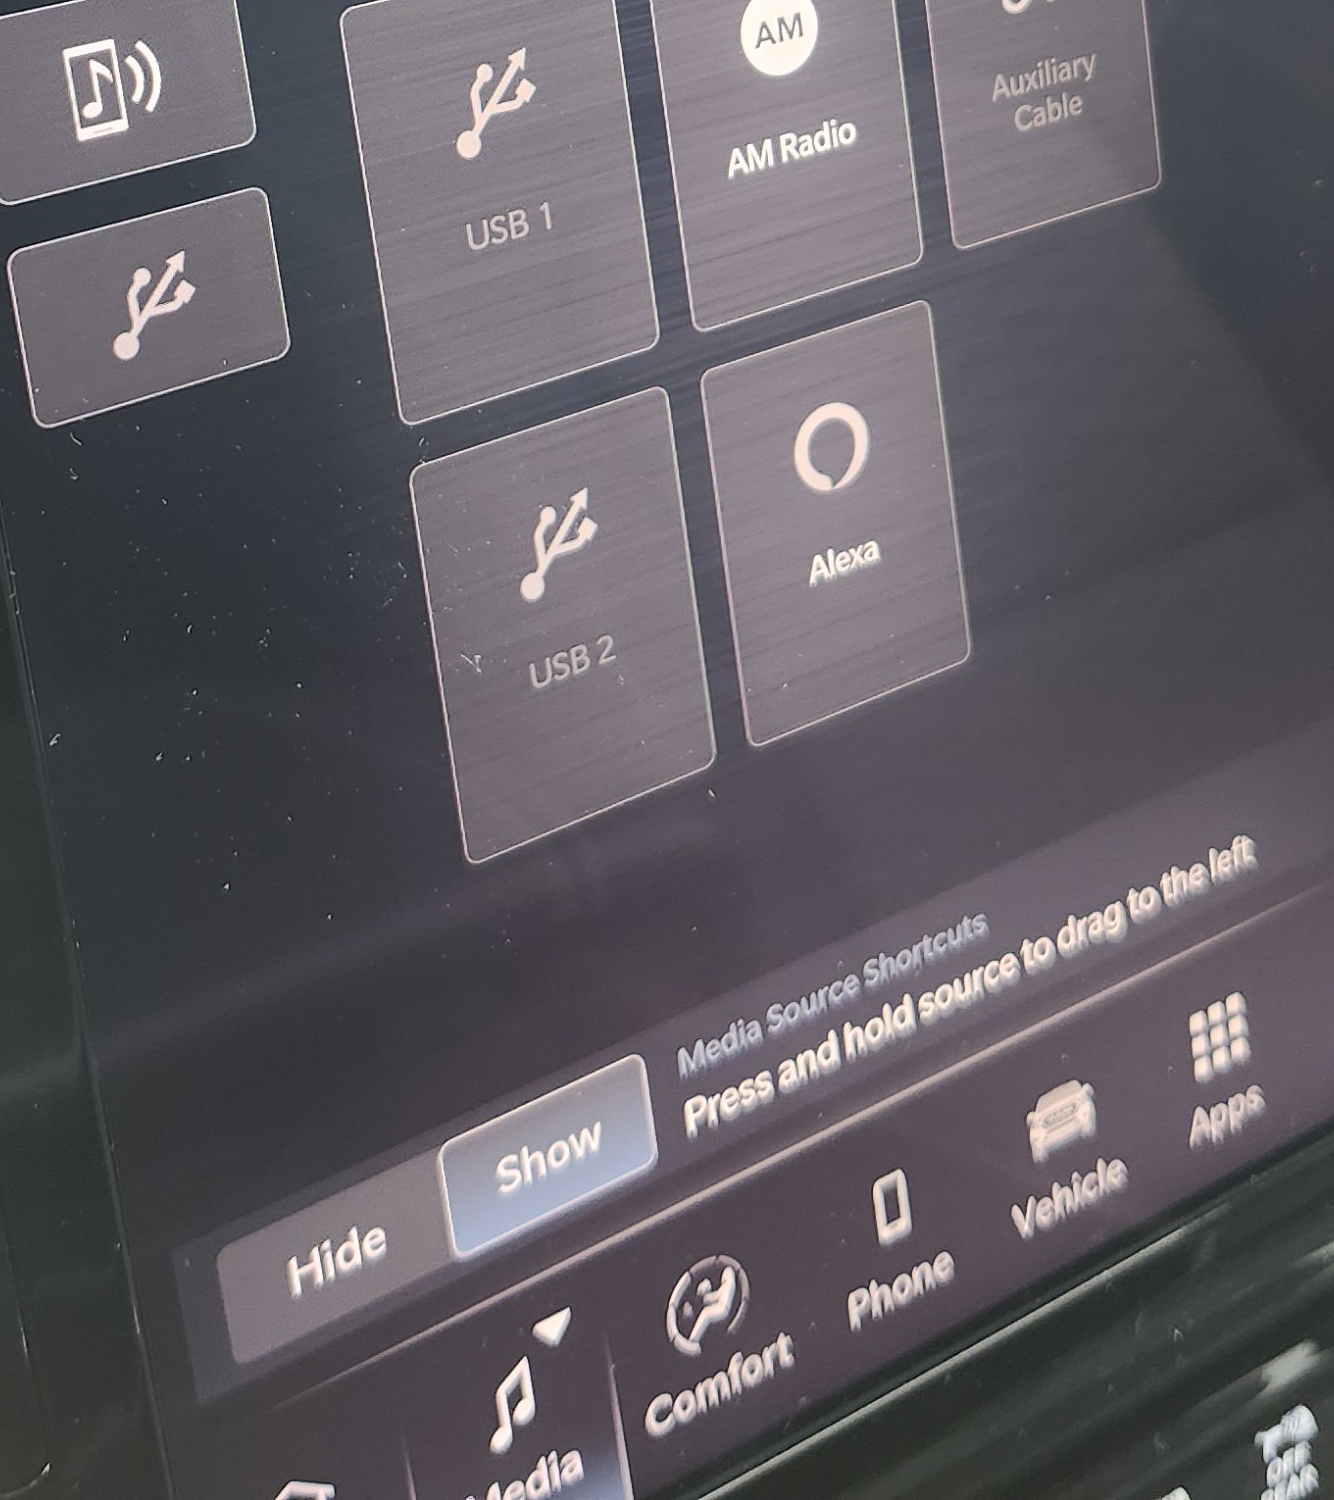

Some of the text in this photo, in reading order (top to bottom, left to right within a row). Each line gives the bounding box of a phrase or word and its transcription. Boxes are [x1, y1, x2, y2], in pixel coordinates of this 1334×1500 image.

[753, 10, 805, 50] AM
[992, 51, 1098, 102] Auxiliary
[1013, 92, 1084, 133] Cable
[726, 116, 858, 179] AM Radio
[466, 201, 555, 252] USB 1
[808, 537, 881, 588] Alexa
[529, 634, 617, 690] USB 2
[677, 911, 991, 1080] Media Source Shortcuts
[682, 833, 1261, 1140] Press and hold source to drag to the left
[1188, 1083, 1267, 1152] Apps
[495, 1118, 603, 1198] Show
[1010, 1156, 1130, 1241] Vehicle
[285, 1223, 390, 1300] Hide
[847, 1250, 956, 1331] Phone
[644, 1330, 797, 1439] Comfort
